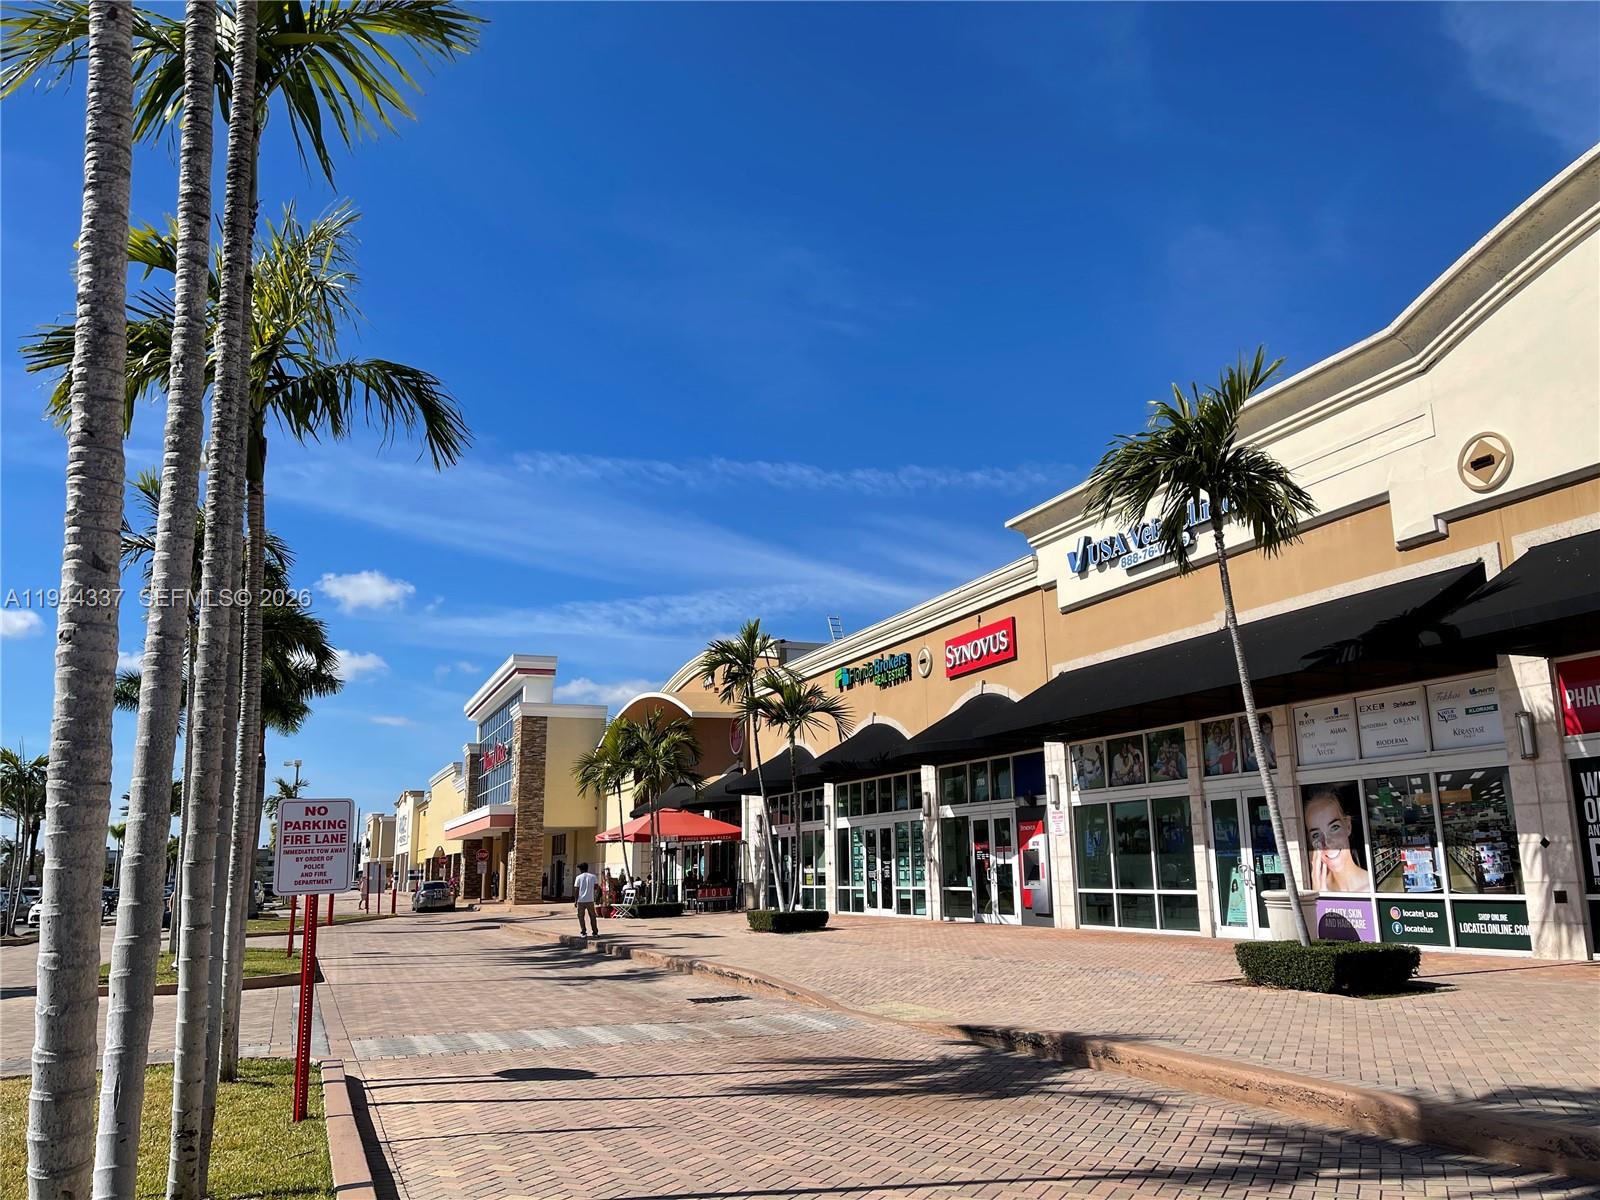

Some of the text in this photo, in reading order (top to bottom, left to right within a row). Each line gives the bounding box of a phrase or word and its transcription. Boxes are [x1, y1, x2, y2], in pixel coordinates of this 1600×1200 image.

[1087, 533, 1127, 565] USA
[946, 629, 1009, 668] SYNOVUS
[874, 664, 908, 686] REAL ESTATE
[1376, 737, 1409, 747] BIODERMA
[1580, 771, 1600, 797] W
[304, 806, 329, 817] NO
[284, 819, 347, 831] PARKING
[283, 833, 347, 845] FIRE LANE
[294, 878, 333, 886] DEPARTMENT
[1325, 907, 1363, 918] BEAUTY, SKIN
[1402, 909, 1439, 919] locatel_usa
[1478, 913, 1509, 922] SHOP ONLINE
[1325, 919, 1367, 930] AND HAIR CARE
[1404, 925, 1434, 934] locatelus
